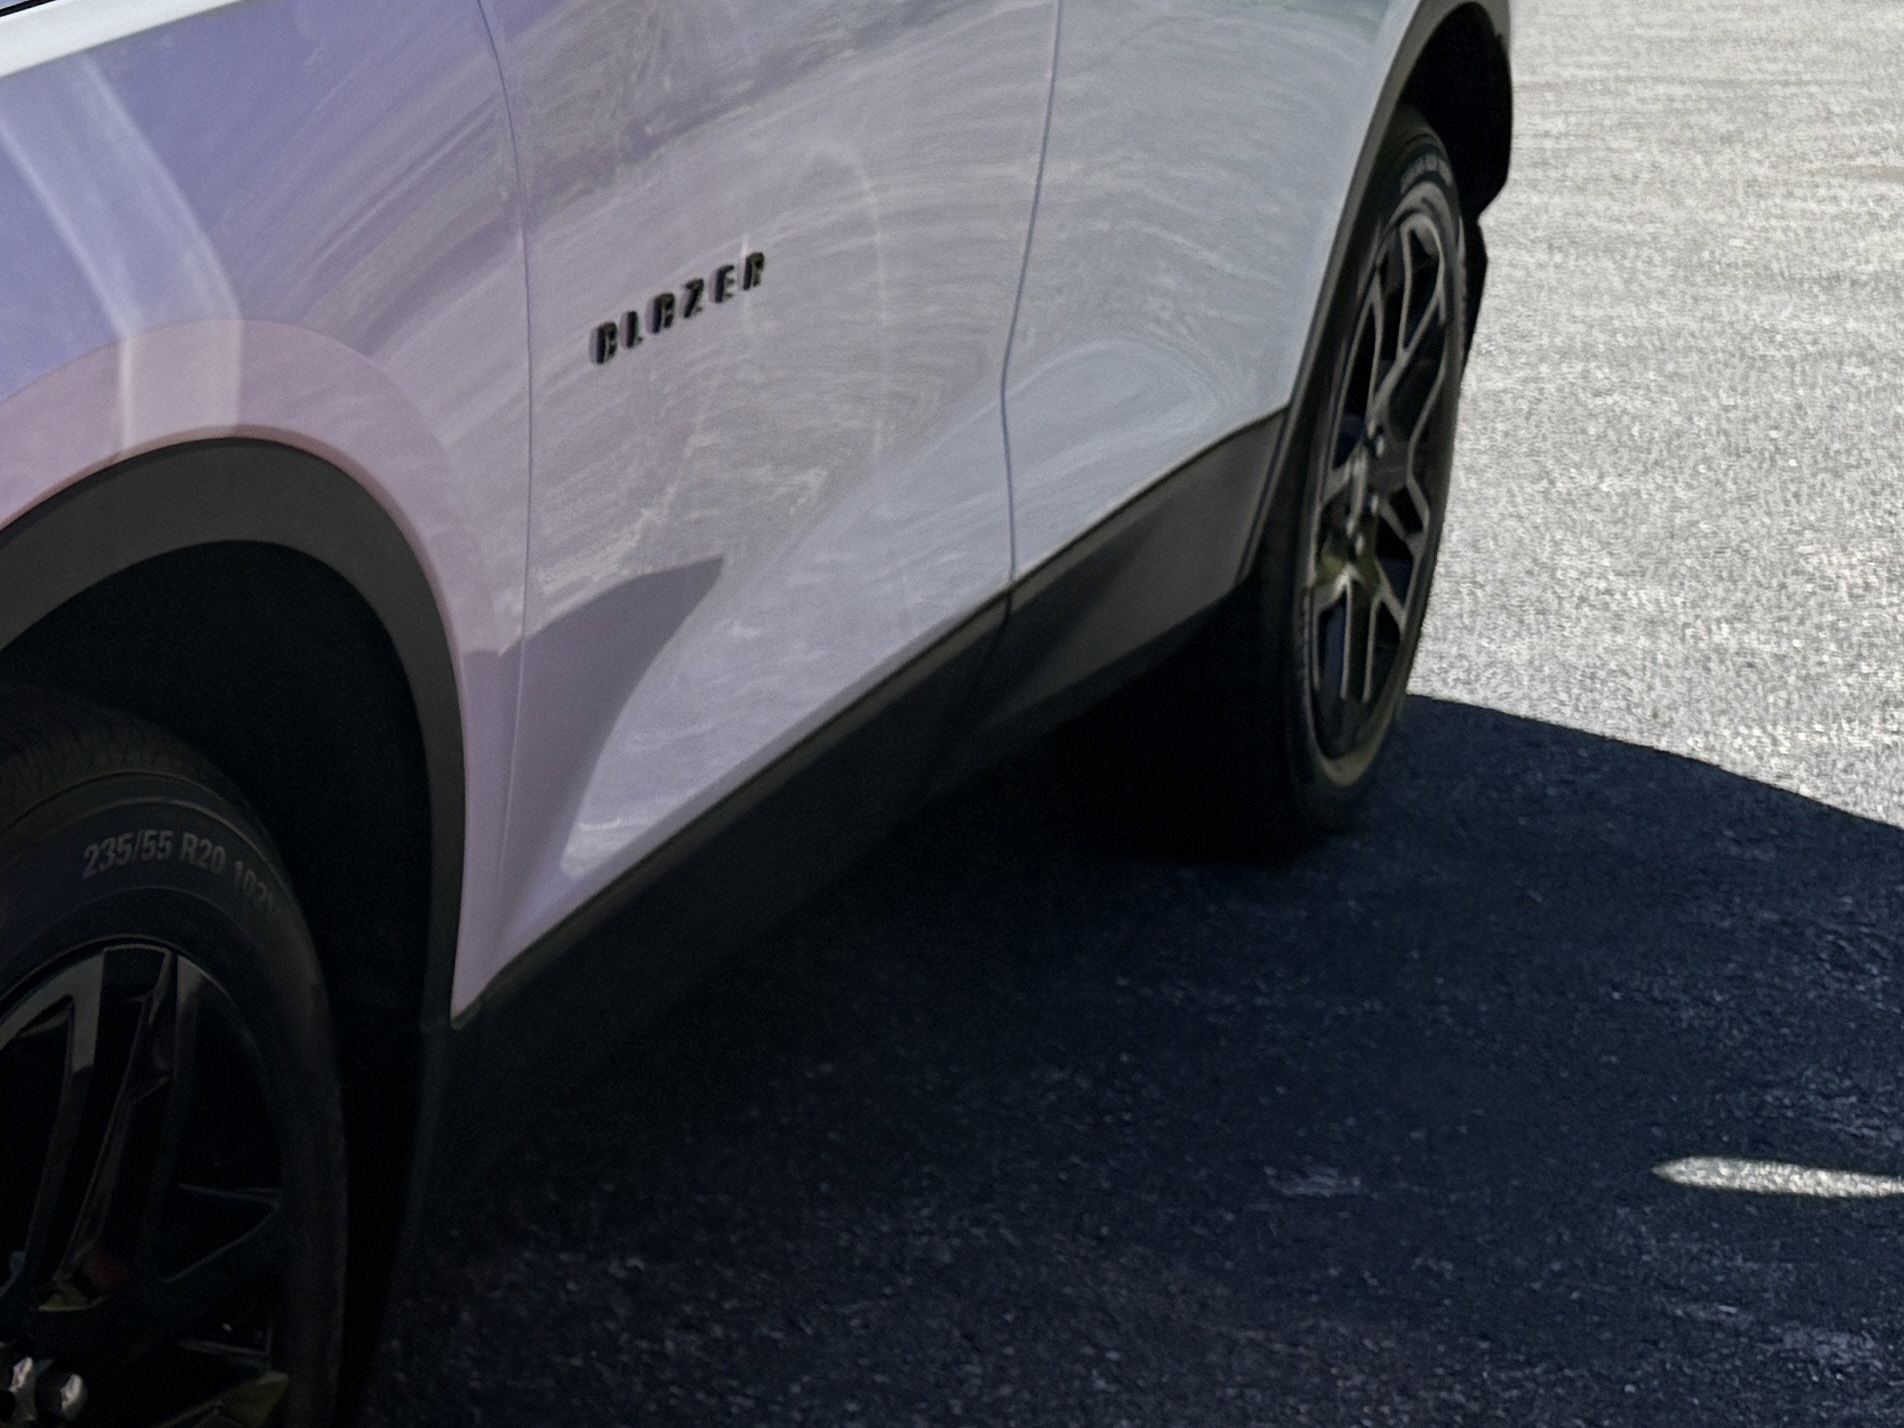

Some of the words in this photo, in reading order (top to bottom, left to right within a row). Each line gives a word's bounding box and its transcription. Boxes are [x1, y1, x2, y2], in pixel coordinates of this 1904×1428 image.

[592, 251, 766, 366] BLAZER
[82, 829, 173, 880] 235/55
[177, 831, 225, 875] R20
